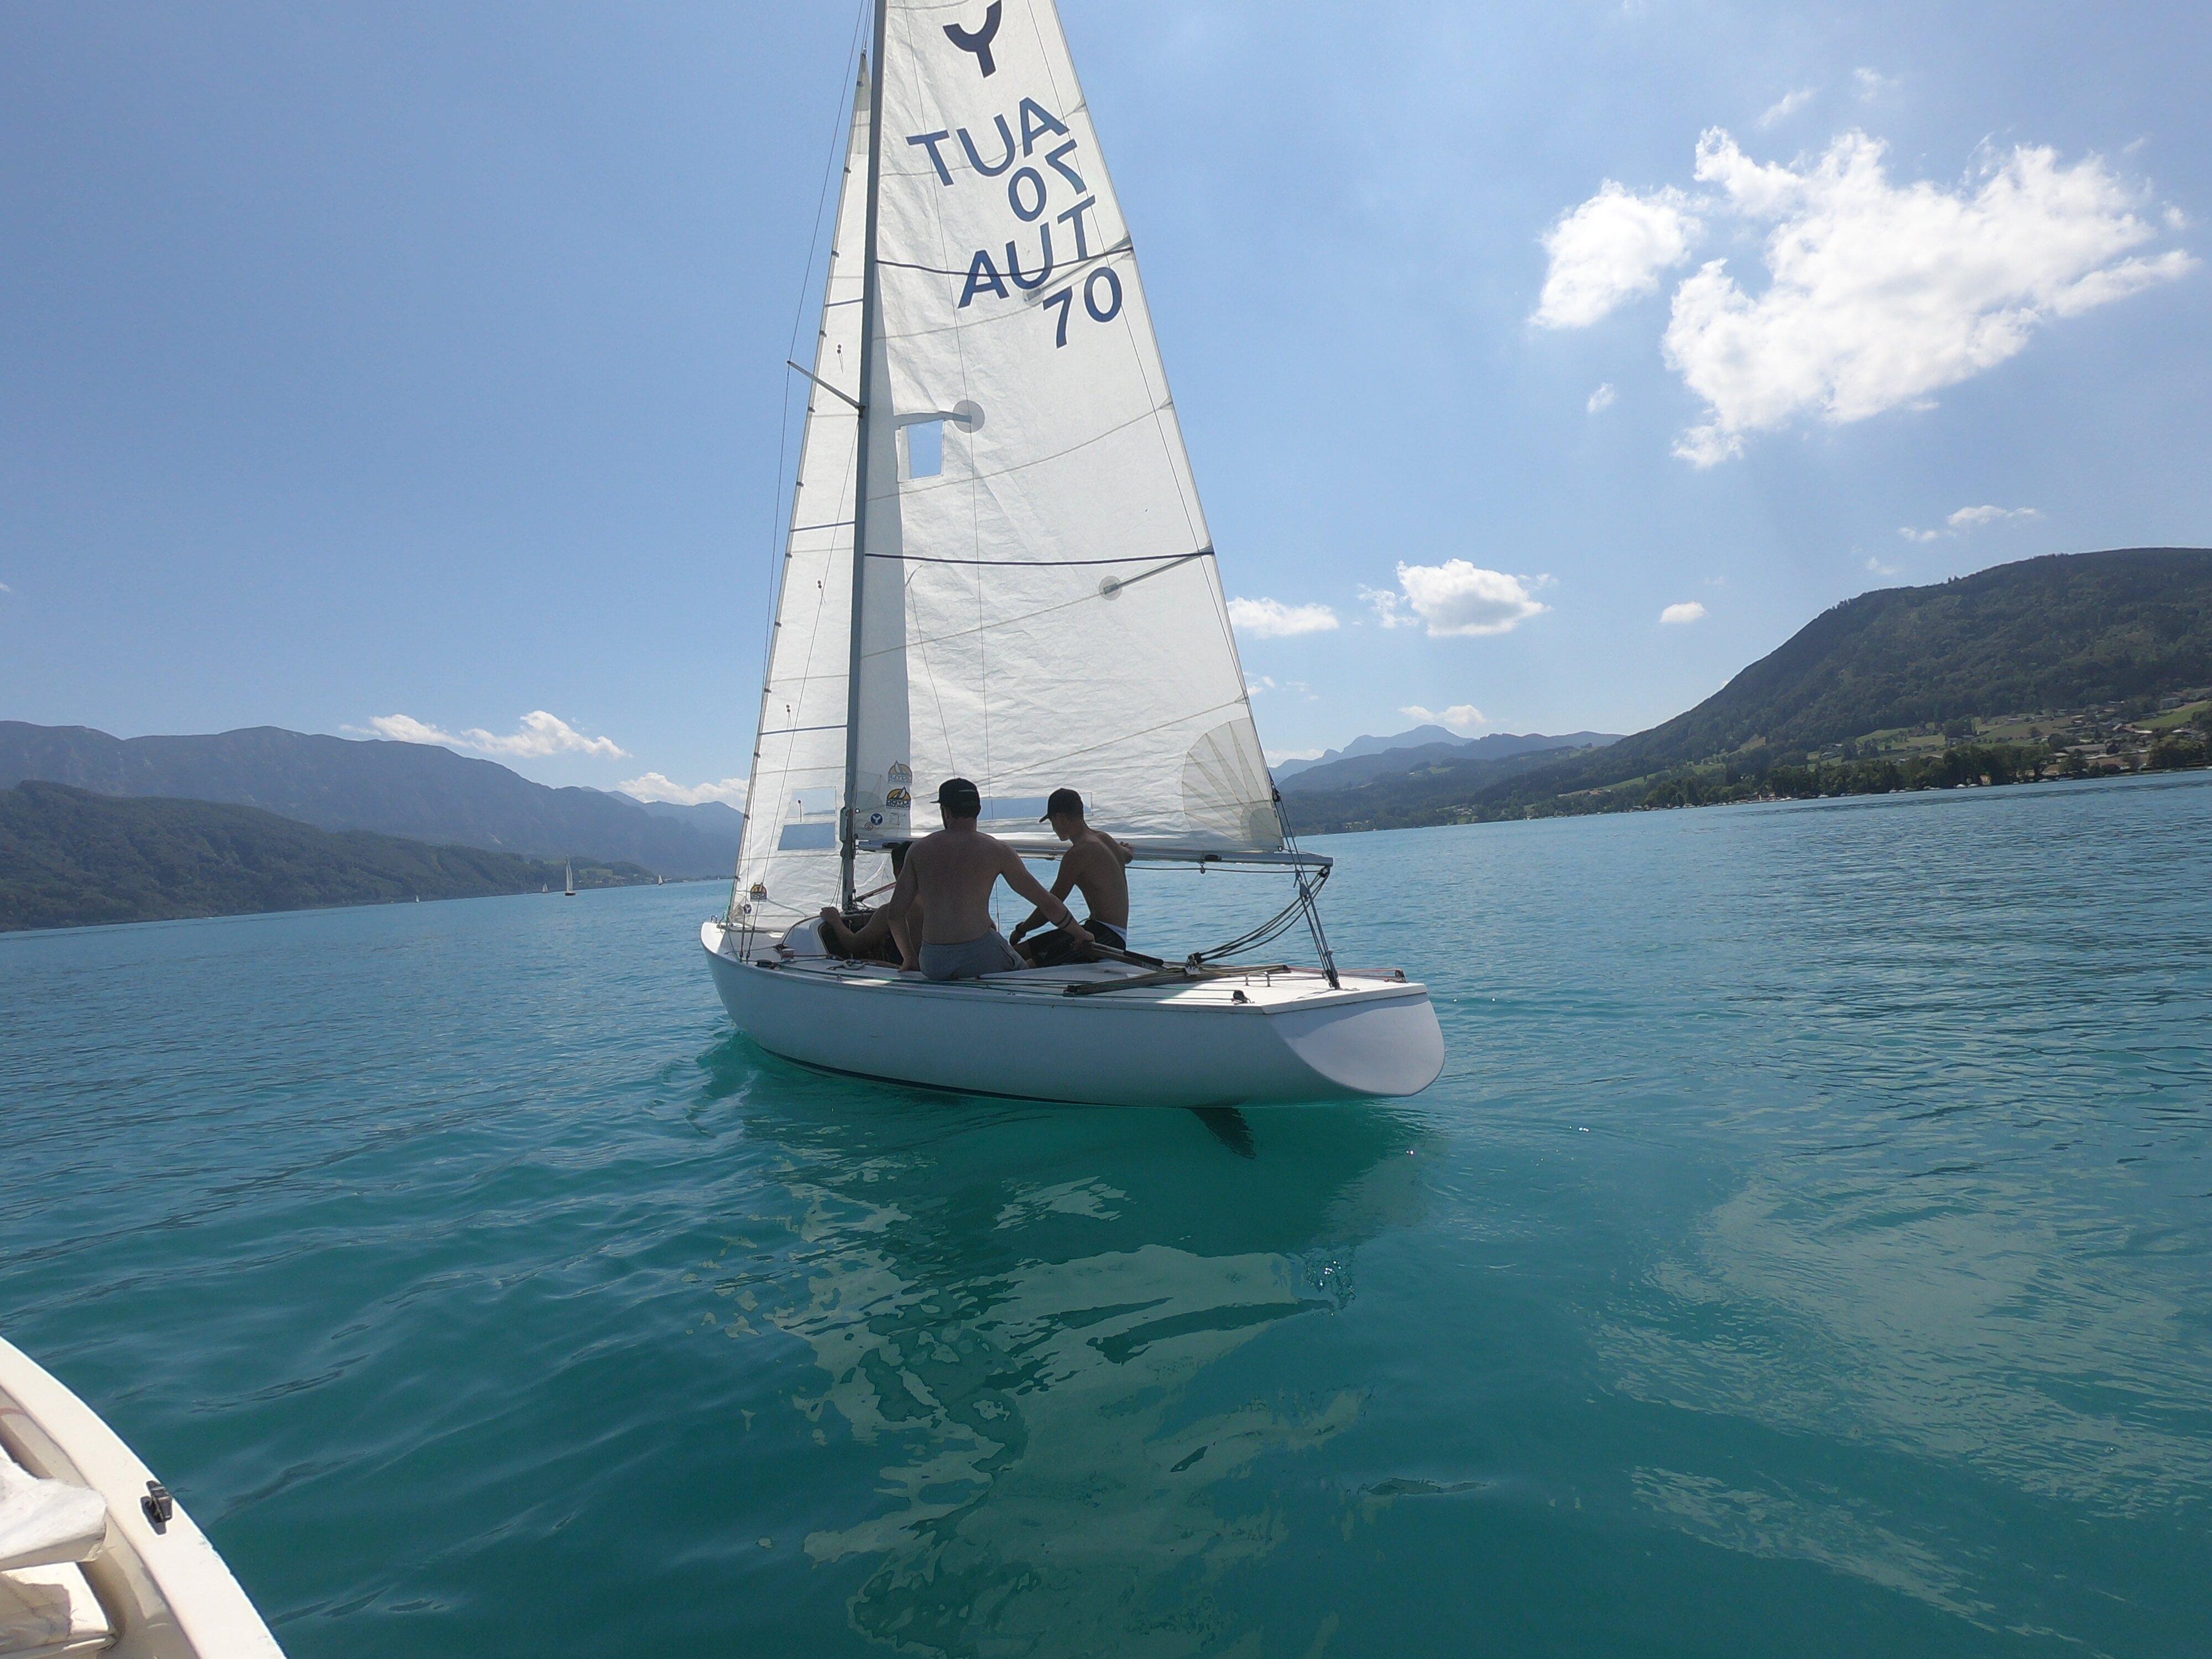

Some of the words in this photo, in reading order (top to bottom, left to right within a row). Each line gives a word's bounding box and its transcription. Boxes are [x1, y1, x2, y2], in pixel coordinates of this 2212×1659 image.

[942, 0, 1002, 77] Y
[957, 195, 1095, 308] AUT
[1043, 267, 1123, 348] 70
